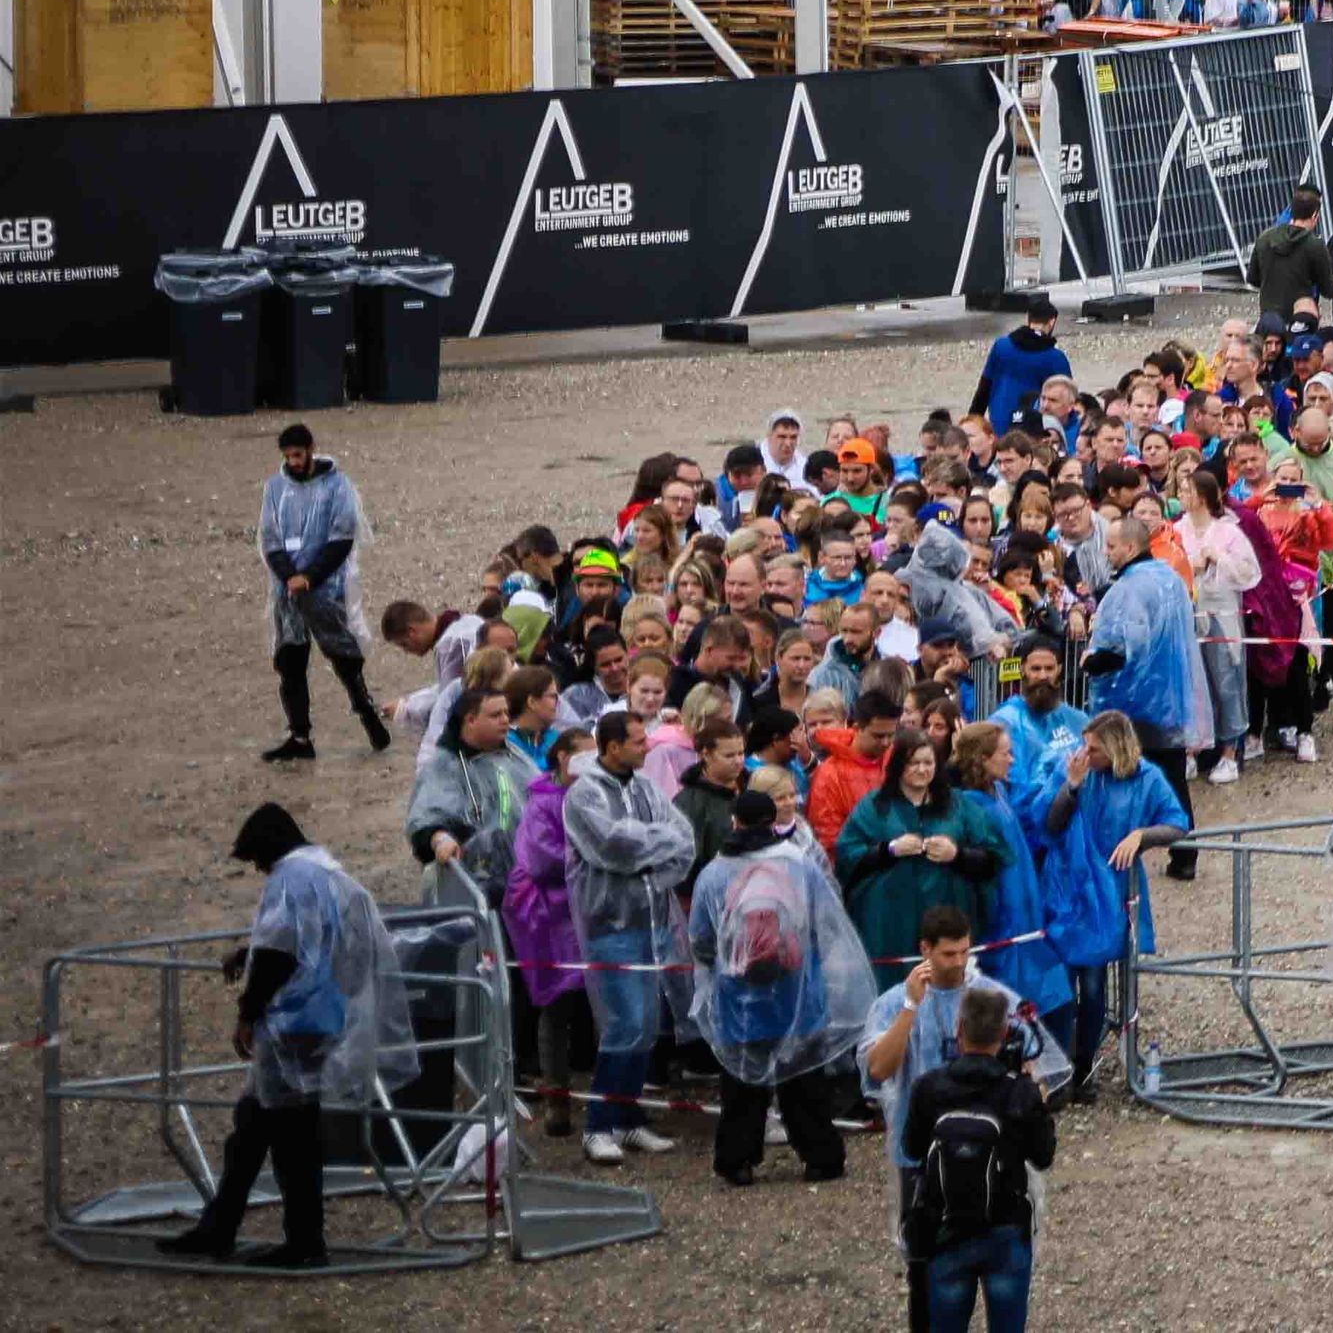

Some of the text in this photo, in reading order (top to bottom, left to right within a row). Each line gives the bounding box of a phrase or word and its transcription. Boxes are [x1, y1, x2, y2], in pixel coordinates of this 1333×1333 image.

[788, 164, 863, 201] LEUTGEB
[535, 183, 633, 219] LEUTGEB
[789, 194, 862, 213] ENTERTAINMENT GROUP
[255, 200, 365, 237] LEUTGEB
[535, 213, 633, 232] ENTERTAINMENT GROUP
[838, 213, 866, 227] CREATE
[868, 210, 911, 224] EMOTIONS
[599, 232, 638, 247] CREATE
[640, 229, 690, 245] EMOTIONS
[20, 249, 54, 263] GROUP
[16, 269, 61, 284] CREATE
[64, 265, 120, 281] EMOTIONS
